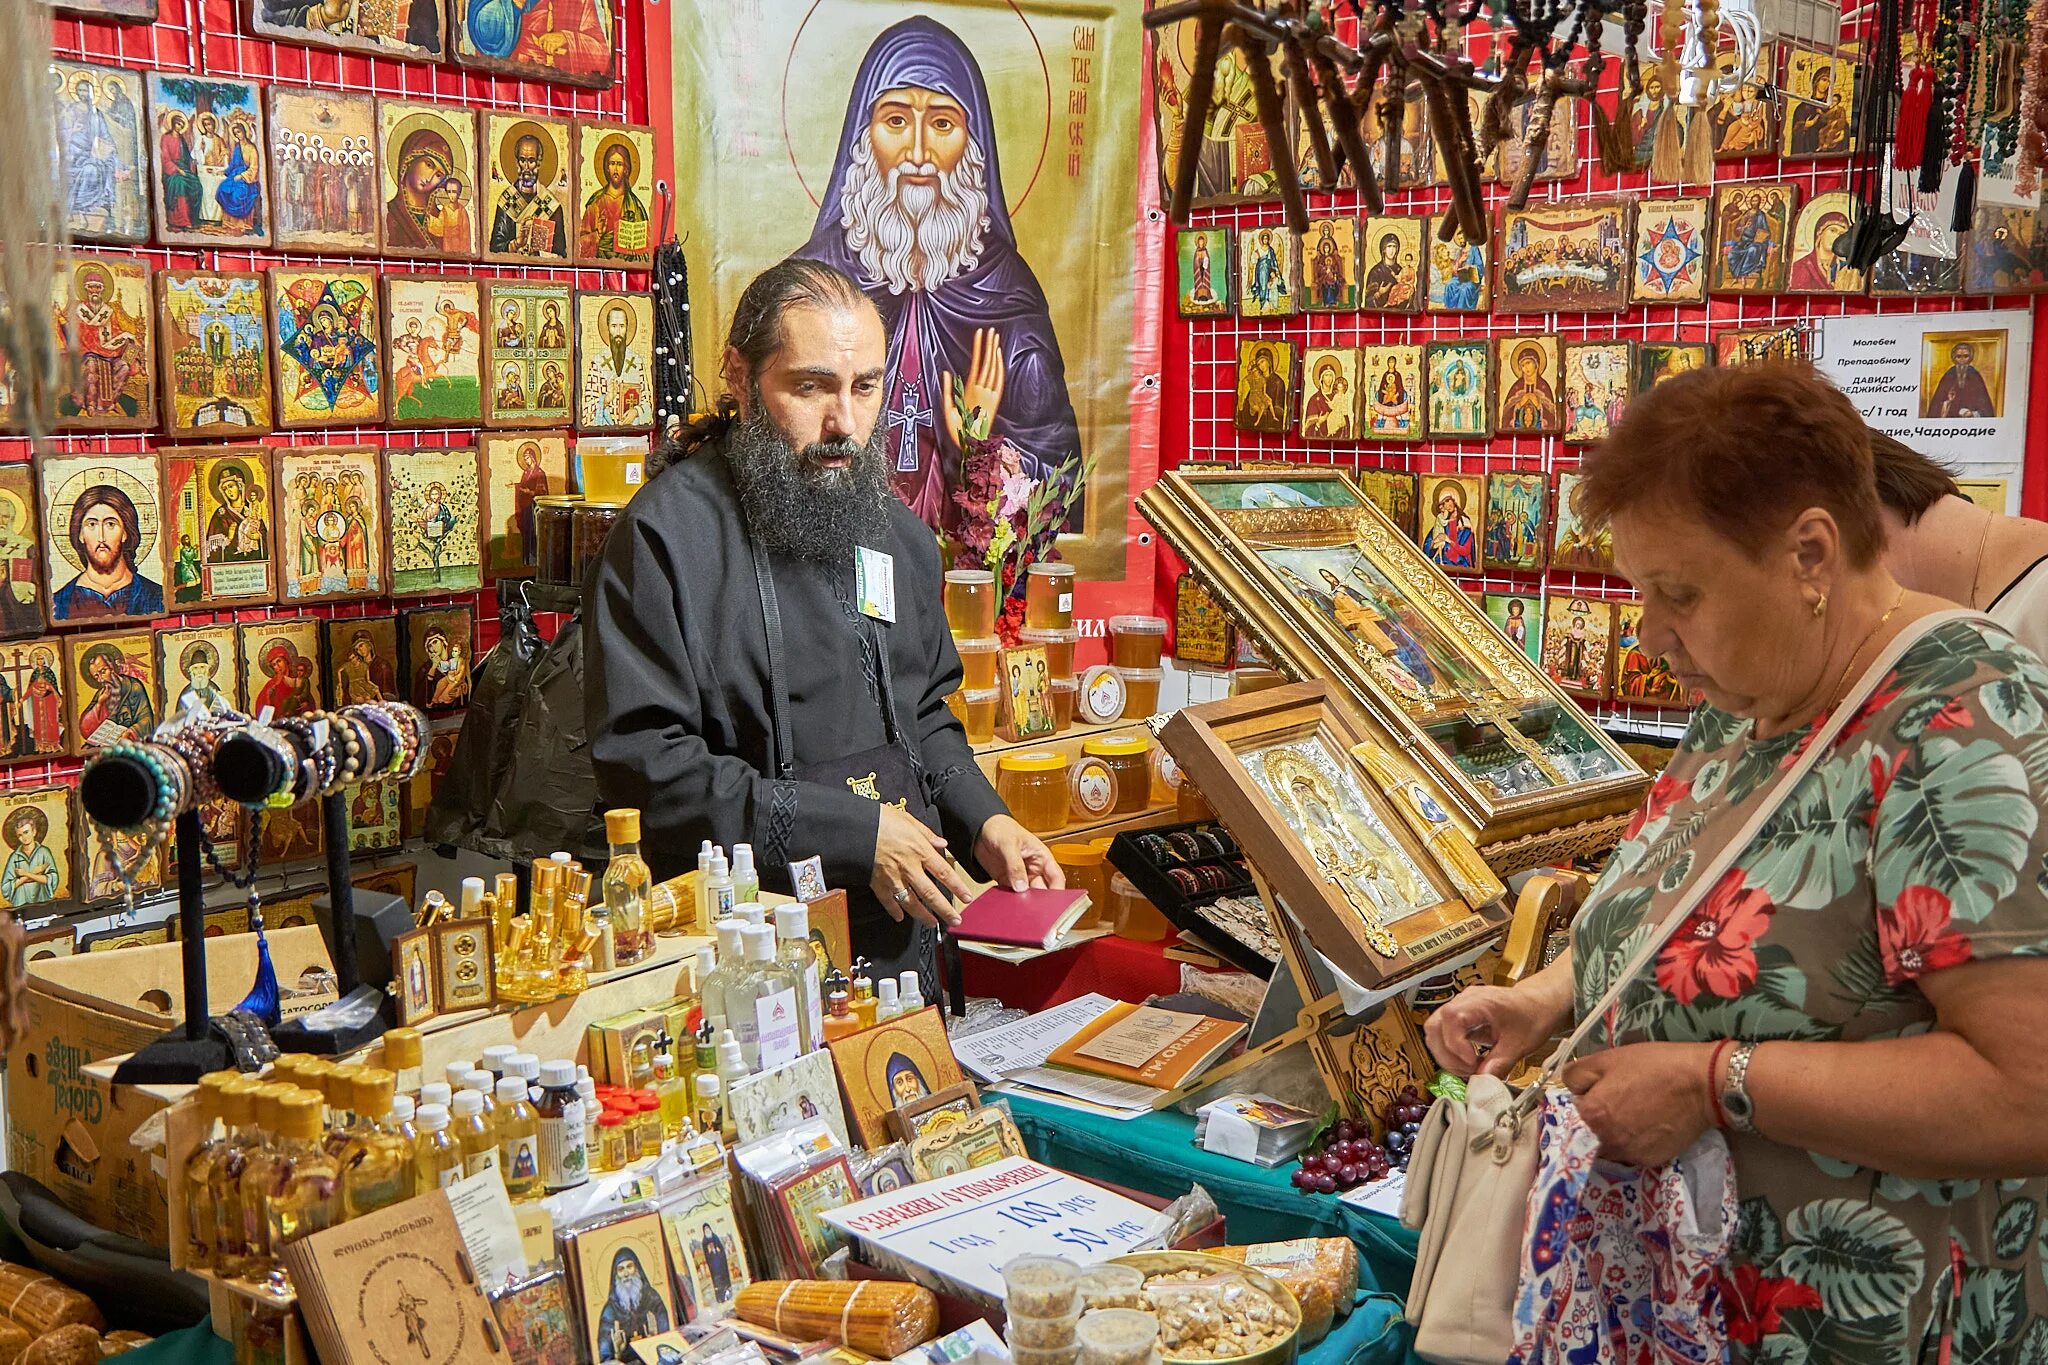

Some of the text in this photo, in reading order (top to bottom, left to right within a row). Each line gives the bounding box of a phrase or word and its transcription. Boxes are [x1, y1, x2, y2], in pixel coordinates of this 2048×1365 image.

[1853, 338, 1896, 347] Молебен
[1837, 356, 1911, 367] Преподобному
[1852, 376, 1896, 385] ДАВИДУ
[1838, 384, 1918, 394] РЕДЖИЙСКОМУ
[1878, 407, 1883, 416] 1
[1885, 408, 1908, 418] год
[1072, 619, 1106, 637] ИЛ
[54, 1085, 103, 1125] Global
[867, 1196, 945, 1231] ЗДРАВИИ
[928, 1240, 956, 1254] 1
[949, 1233, 997, 1250] год
[996, 1200, 1062, 1229] 100
[1057, 1194, 1097, 1216] руб
[1052, 1226, 1108, 1252] 50
[1105, 1219, 1144, 1243] руб
